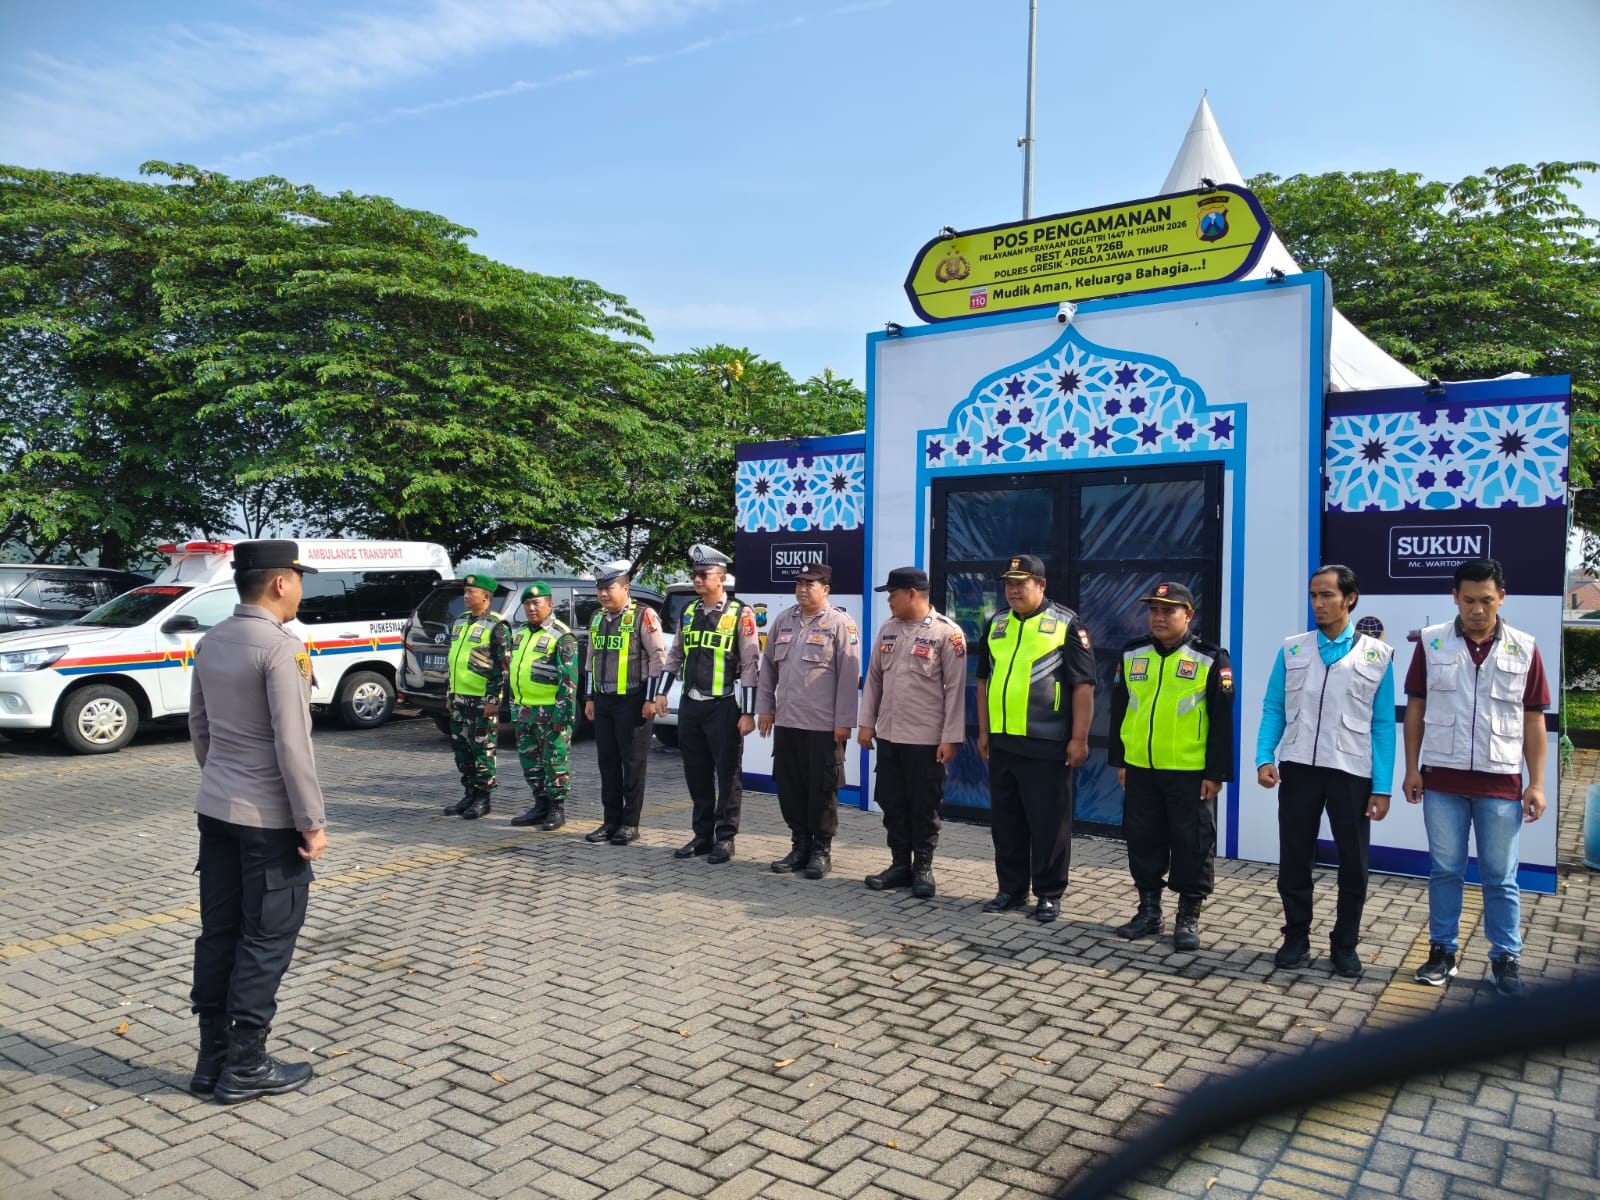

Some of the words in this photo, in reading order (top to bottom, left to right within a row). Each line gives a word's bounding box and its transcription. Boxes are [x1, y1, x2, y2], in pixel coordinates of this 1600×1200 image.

[993, 230, 1028, 251] POS
[1033, 205, 1171, 243] PENGAMANAN
[979, 248, 1023, 262] PELAYANAN
[1025, 241, 1065, 254] PERAYAAN
[1067, 233, 1106, 246] IDULFITRI
[1108, 230, 1126, 240] 1447
[1128, 229, 1134, 237] H
[1136, 224, 1165, 235] TAHUN
[1167, 220, 1187, 230] 2026
[1035, 250, 1061, 264] REST
[1063, 245, 1093, 259] AREA
[1096, 240, 1124, 253] 726B
[994, 266, 1028, 279] POLRES
[1030, 260, 1063, 273] GRESIK
[1070, 255, 1104, 266] POLDA
[1106, 249, 1135, 261] JAWA
[1137, 244, 1169, 257] TIMUR
[993, 285, 1030, 300] Mudik
[1033, 280, 1072, 294] Aman,
[1075, 272, 1132, 287] Keluarga
[1136, 258, 1206, 279] Bahagia...!
[971, 297, 986, 307] 110
[308, 548, 357, 560] AMBULANCE
[357, 548, 403, 559] TRANSPORT
[1397, 535, 1482, 555] SUKUN
[775, 550, 823, 566] SUKUN
[914, 637, 937, 646] POLRI
